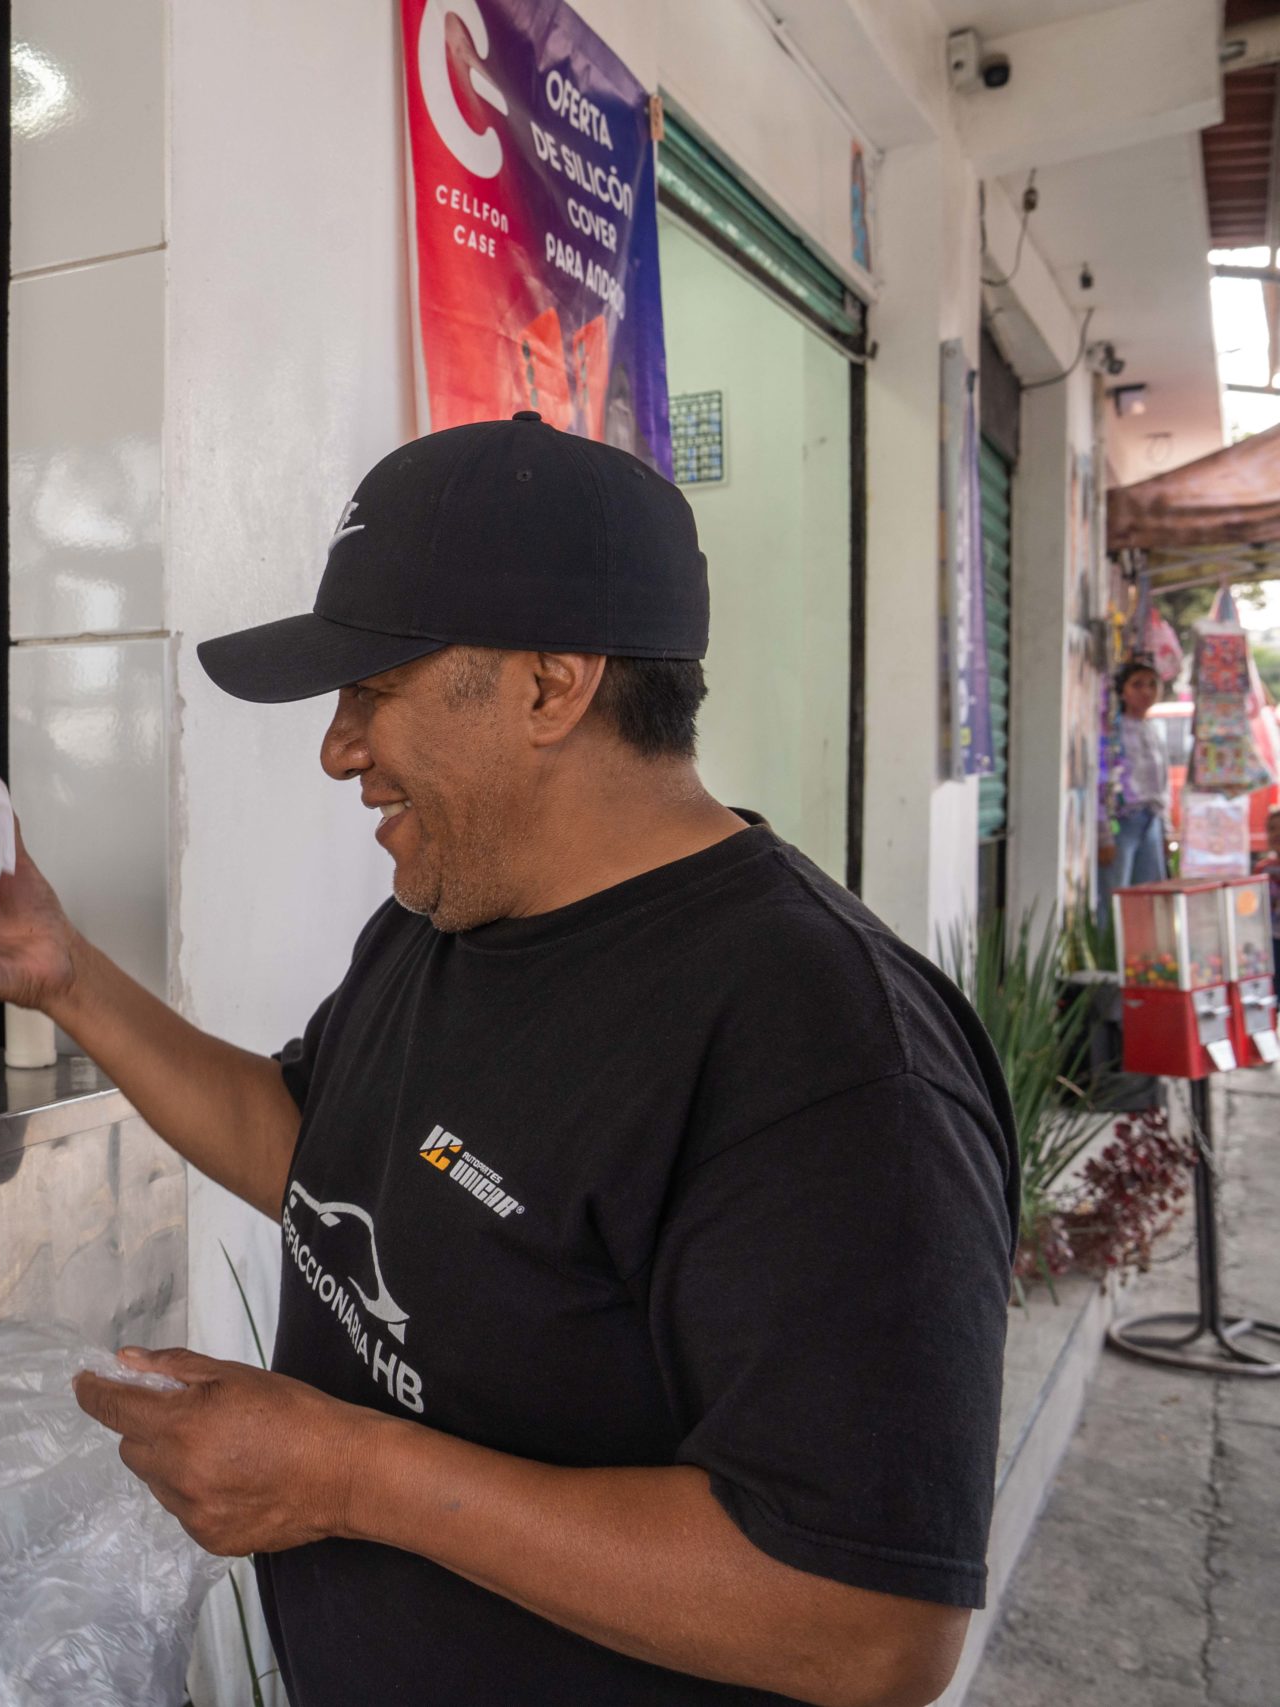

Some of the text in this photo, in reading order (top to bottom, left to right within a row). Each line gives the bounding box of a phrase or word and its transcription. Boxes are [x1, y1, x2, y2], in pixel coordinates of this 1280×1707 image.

[546, 70, 613, 150] OFERTA
[530, 121, 562, 172] DE
[435, 185, 508, 234] CELLFON
[567, 198, 617, 253] COVER
[453, 225, 496, 258] CASE
[545, 232, 584, 284] PARA
[372, 1339, 424, 1414] HB
